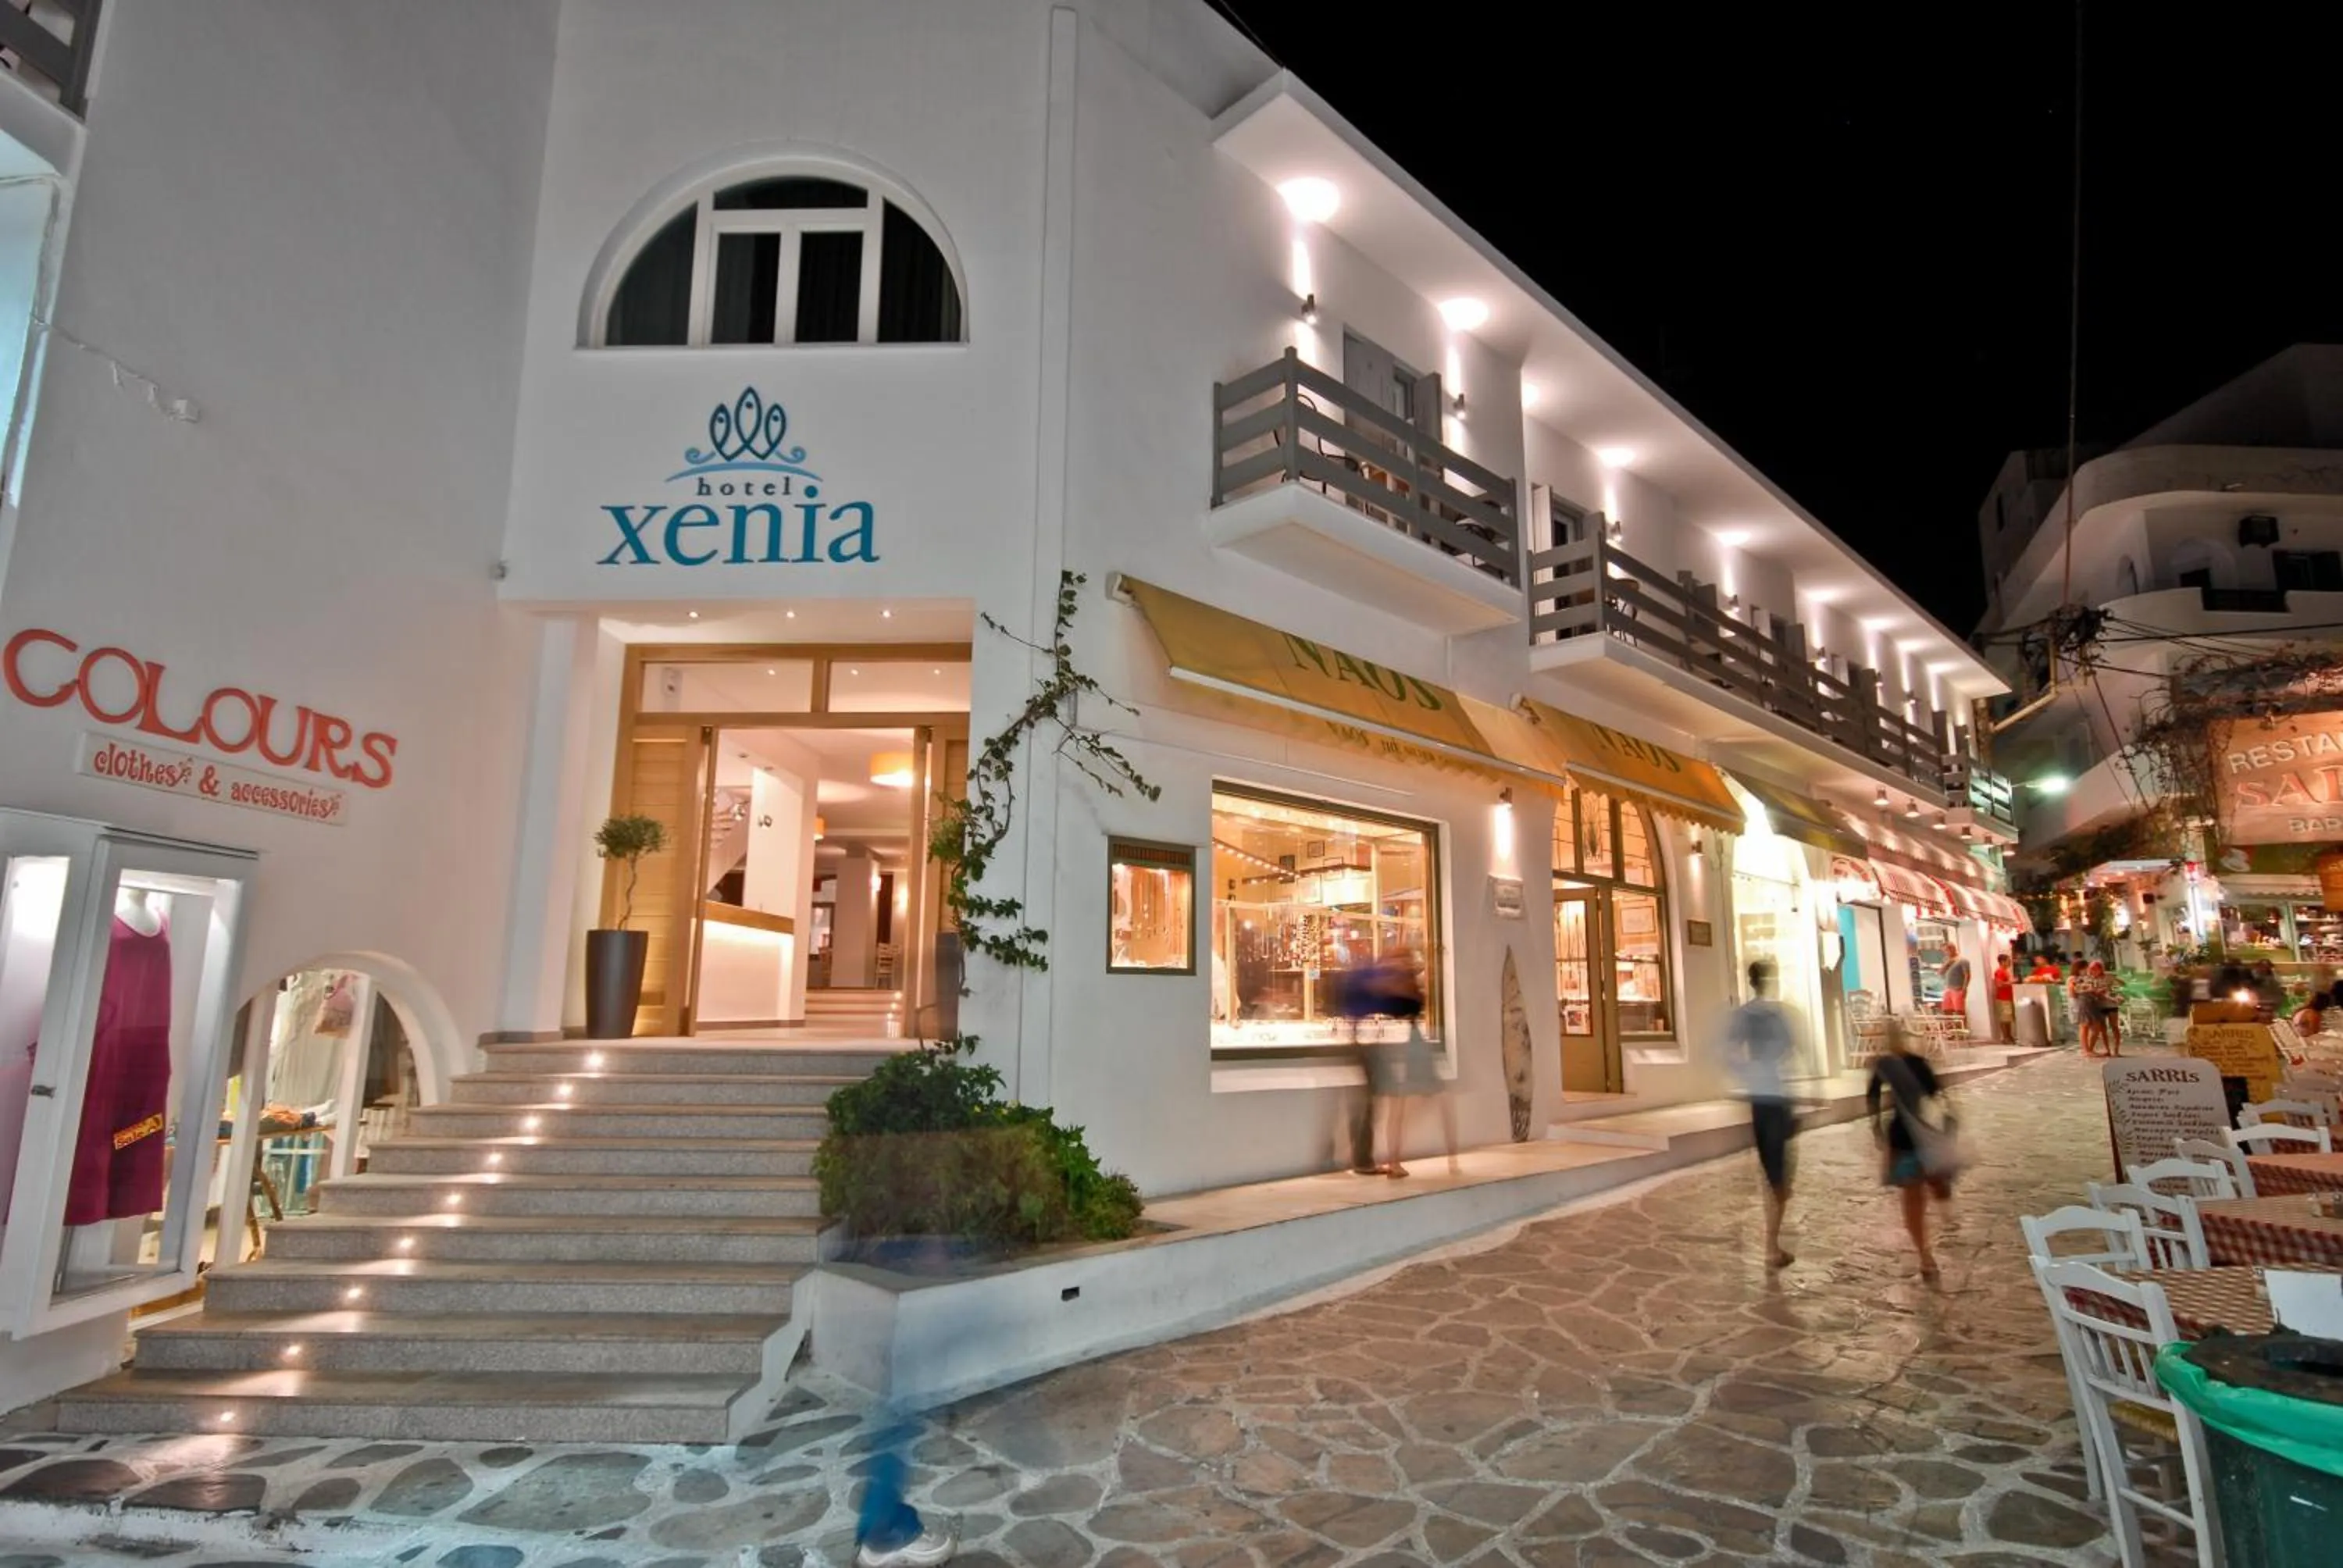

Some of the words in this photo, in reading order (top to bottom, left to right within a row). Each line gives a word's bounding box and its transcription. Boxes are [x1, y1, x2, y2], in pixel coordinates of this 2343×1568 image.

[697, 477, 792, 496] hotel
[596, 486, 881, 565] xenia
[3, 629, 398, 788] COLOURS
[1282, 631, 1443, 711] NAOS
[94, 743, 193, 787] clothes
[198, 765, 219, 797] &
[230, 782, 341, 818] accessories
[2228, 732, 2343, 774] RESTA
[2126, 1067, 2200, 1083] SARRIS
